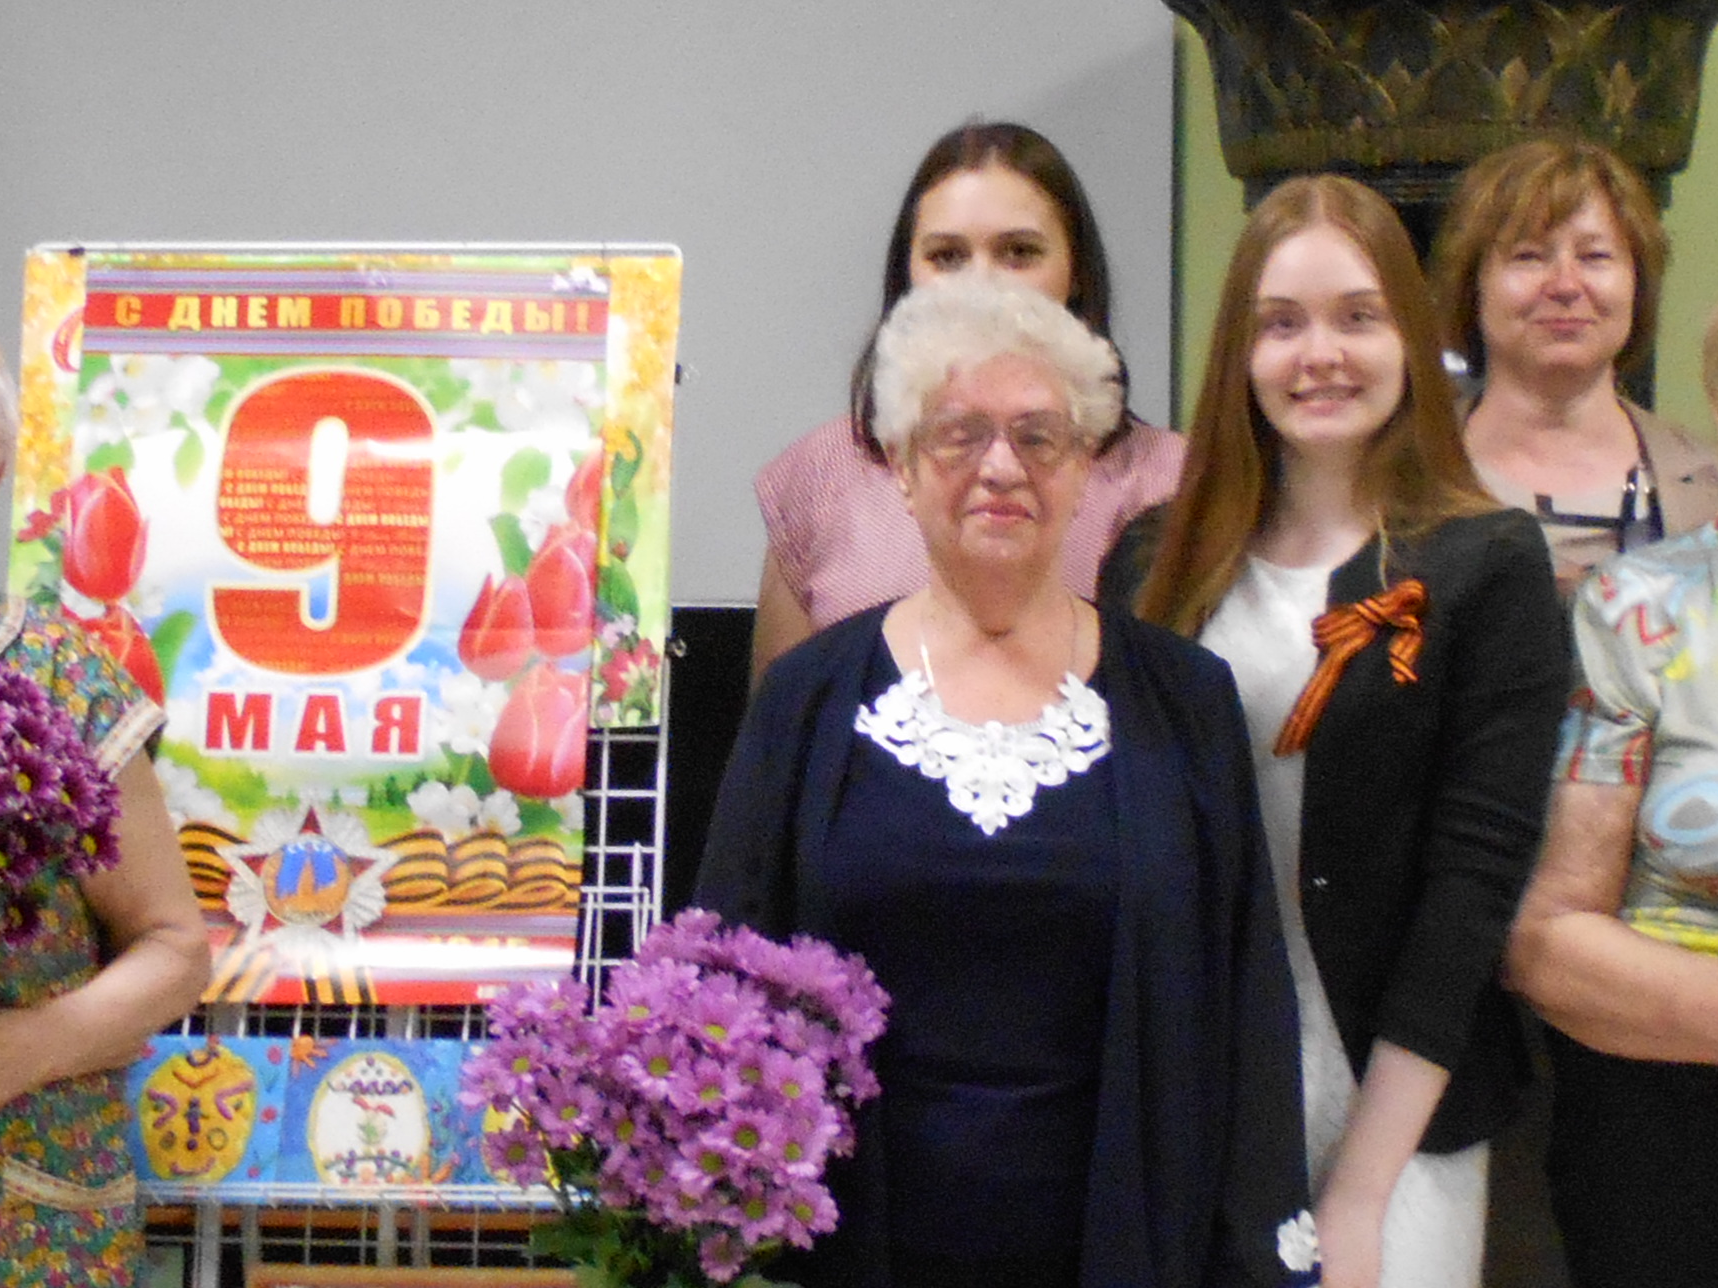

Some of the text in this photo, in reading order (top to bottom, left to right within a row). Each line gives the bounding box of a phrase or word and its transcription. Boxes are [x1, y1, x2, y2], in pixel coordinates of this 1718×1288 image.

[115, 295, 589, 335] С ДНЕМ ПОБЕДЫ!
[208, 367, 434, 674] 9
[205, 692, 422, 754] МАЯ
